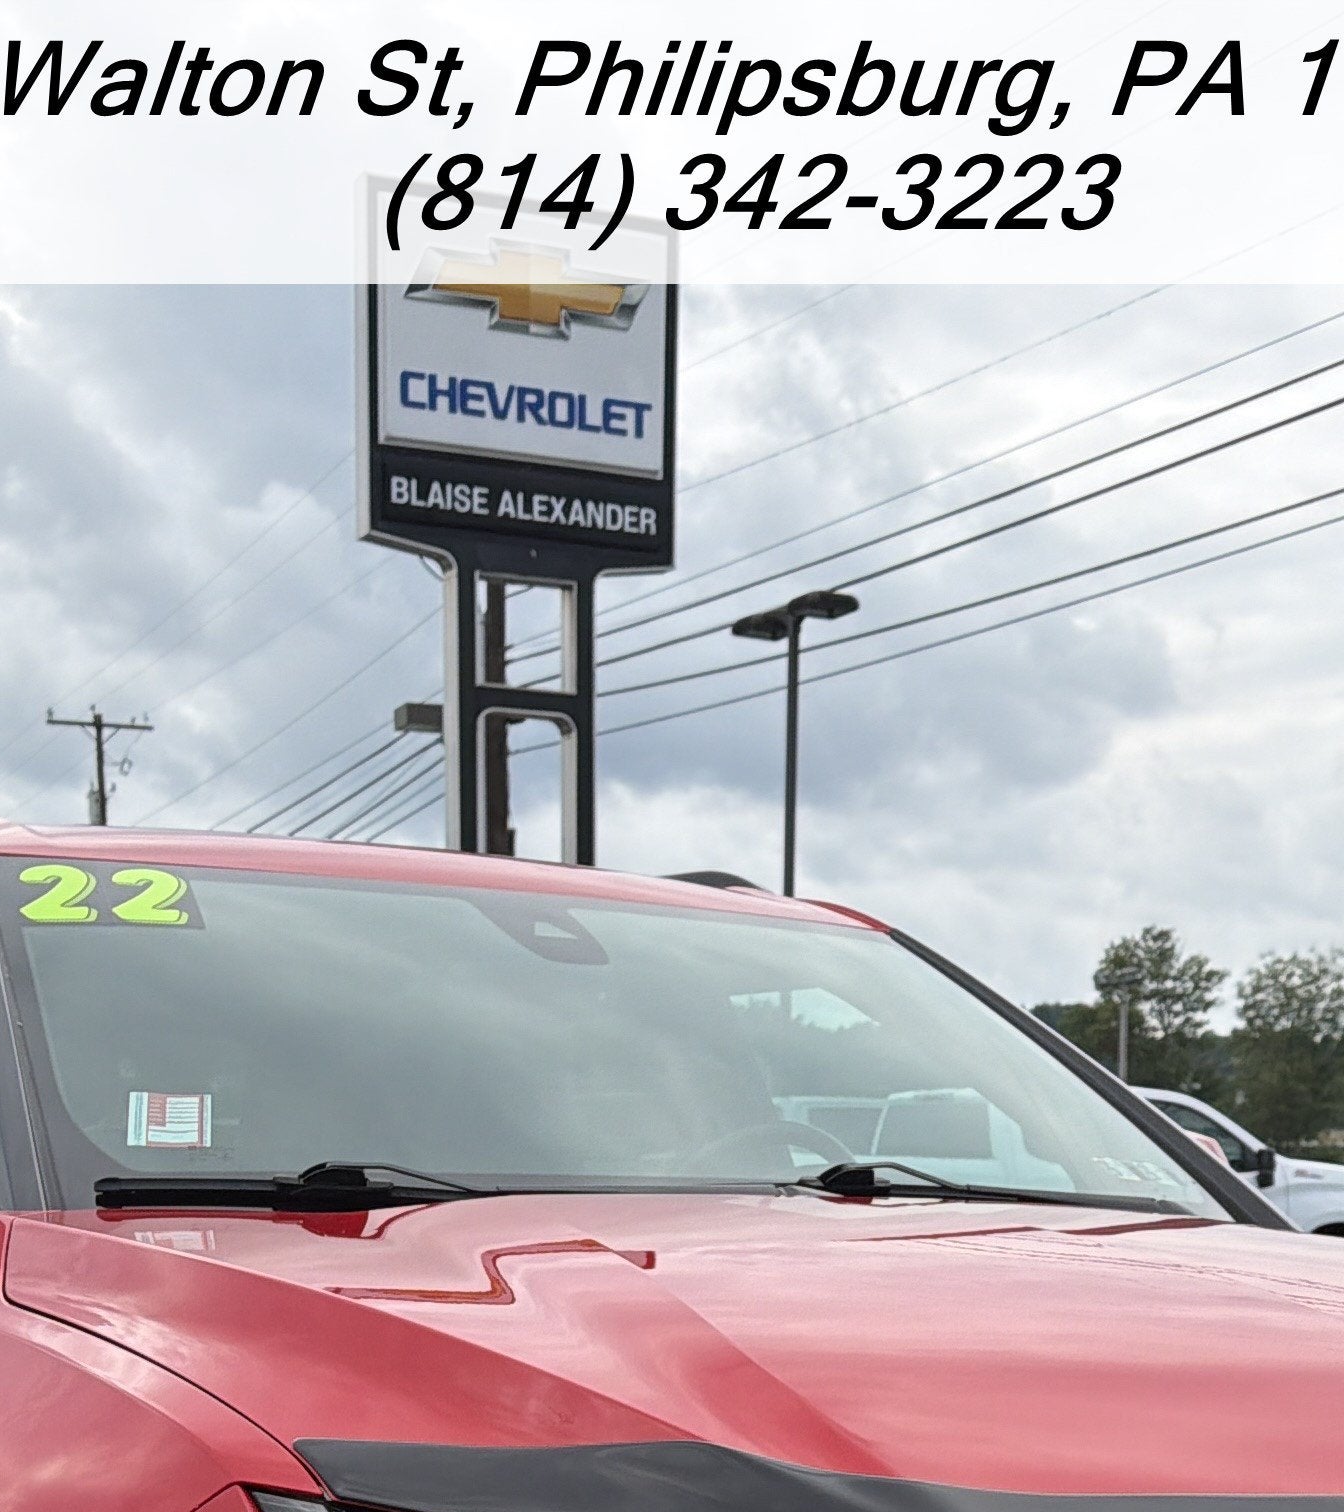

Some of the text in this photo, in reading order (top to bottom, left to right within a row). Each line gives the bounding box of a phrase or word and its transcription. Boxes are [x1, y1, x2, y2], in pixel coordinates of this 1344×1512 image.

[399, 370, 653, 439] CHEVROLET
[390, 474, 658, 536] BLAISE ALEXANDER
[19, 864, 190, 925] 22
